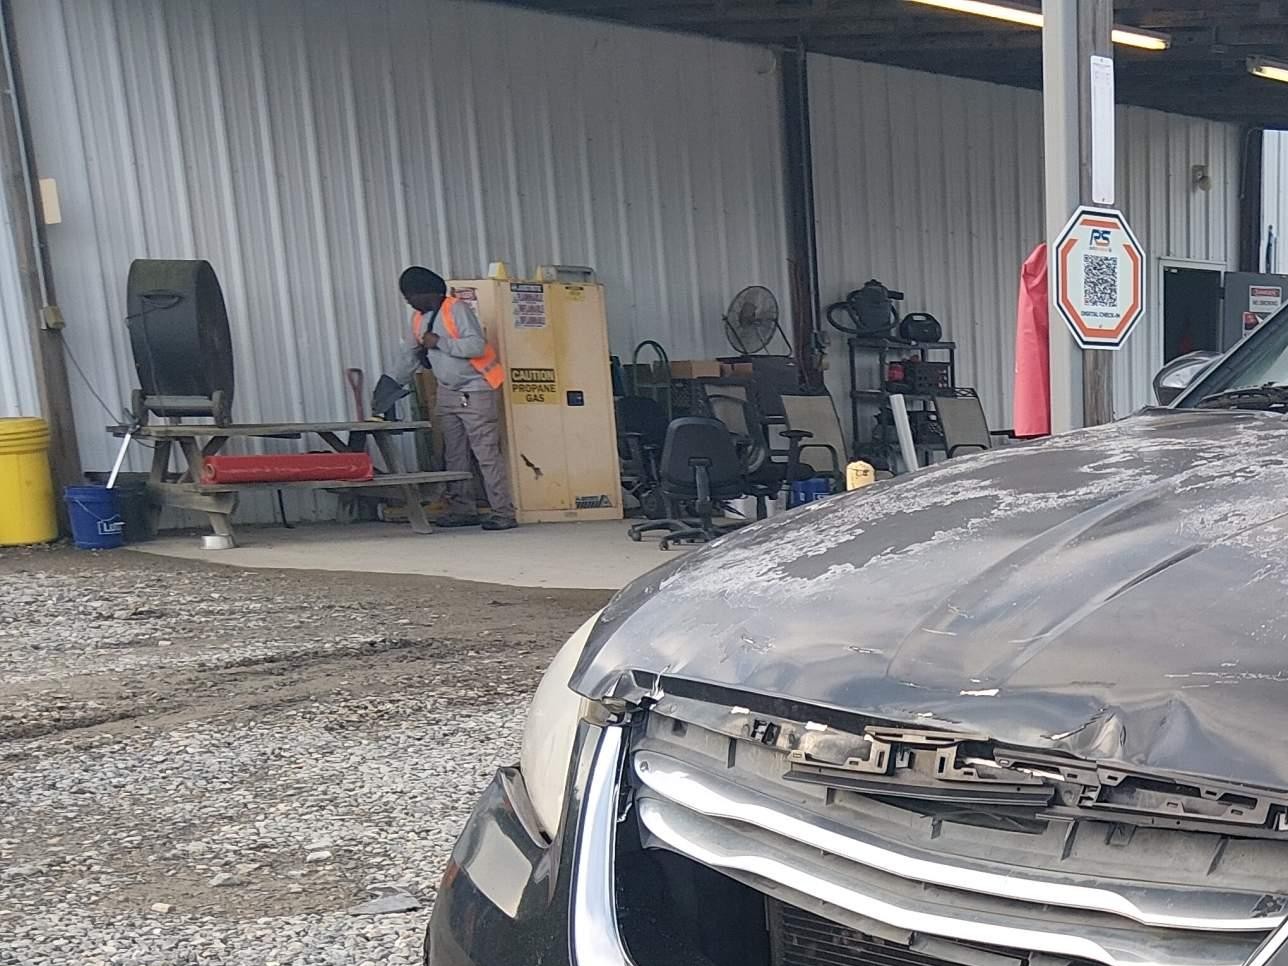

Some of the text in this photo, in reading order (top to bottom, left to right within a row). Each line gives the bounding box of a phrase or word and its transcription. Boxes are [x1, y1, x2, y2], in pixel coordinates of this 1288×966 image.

[512, 369, 554, 381] CAUTION
[512, 384, 557, 393] PROPANE
[527, 394, 545, 402] GAS
